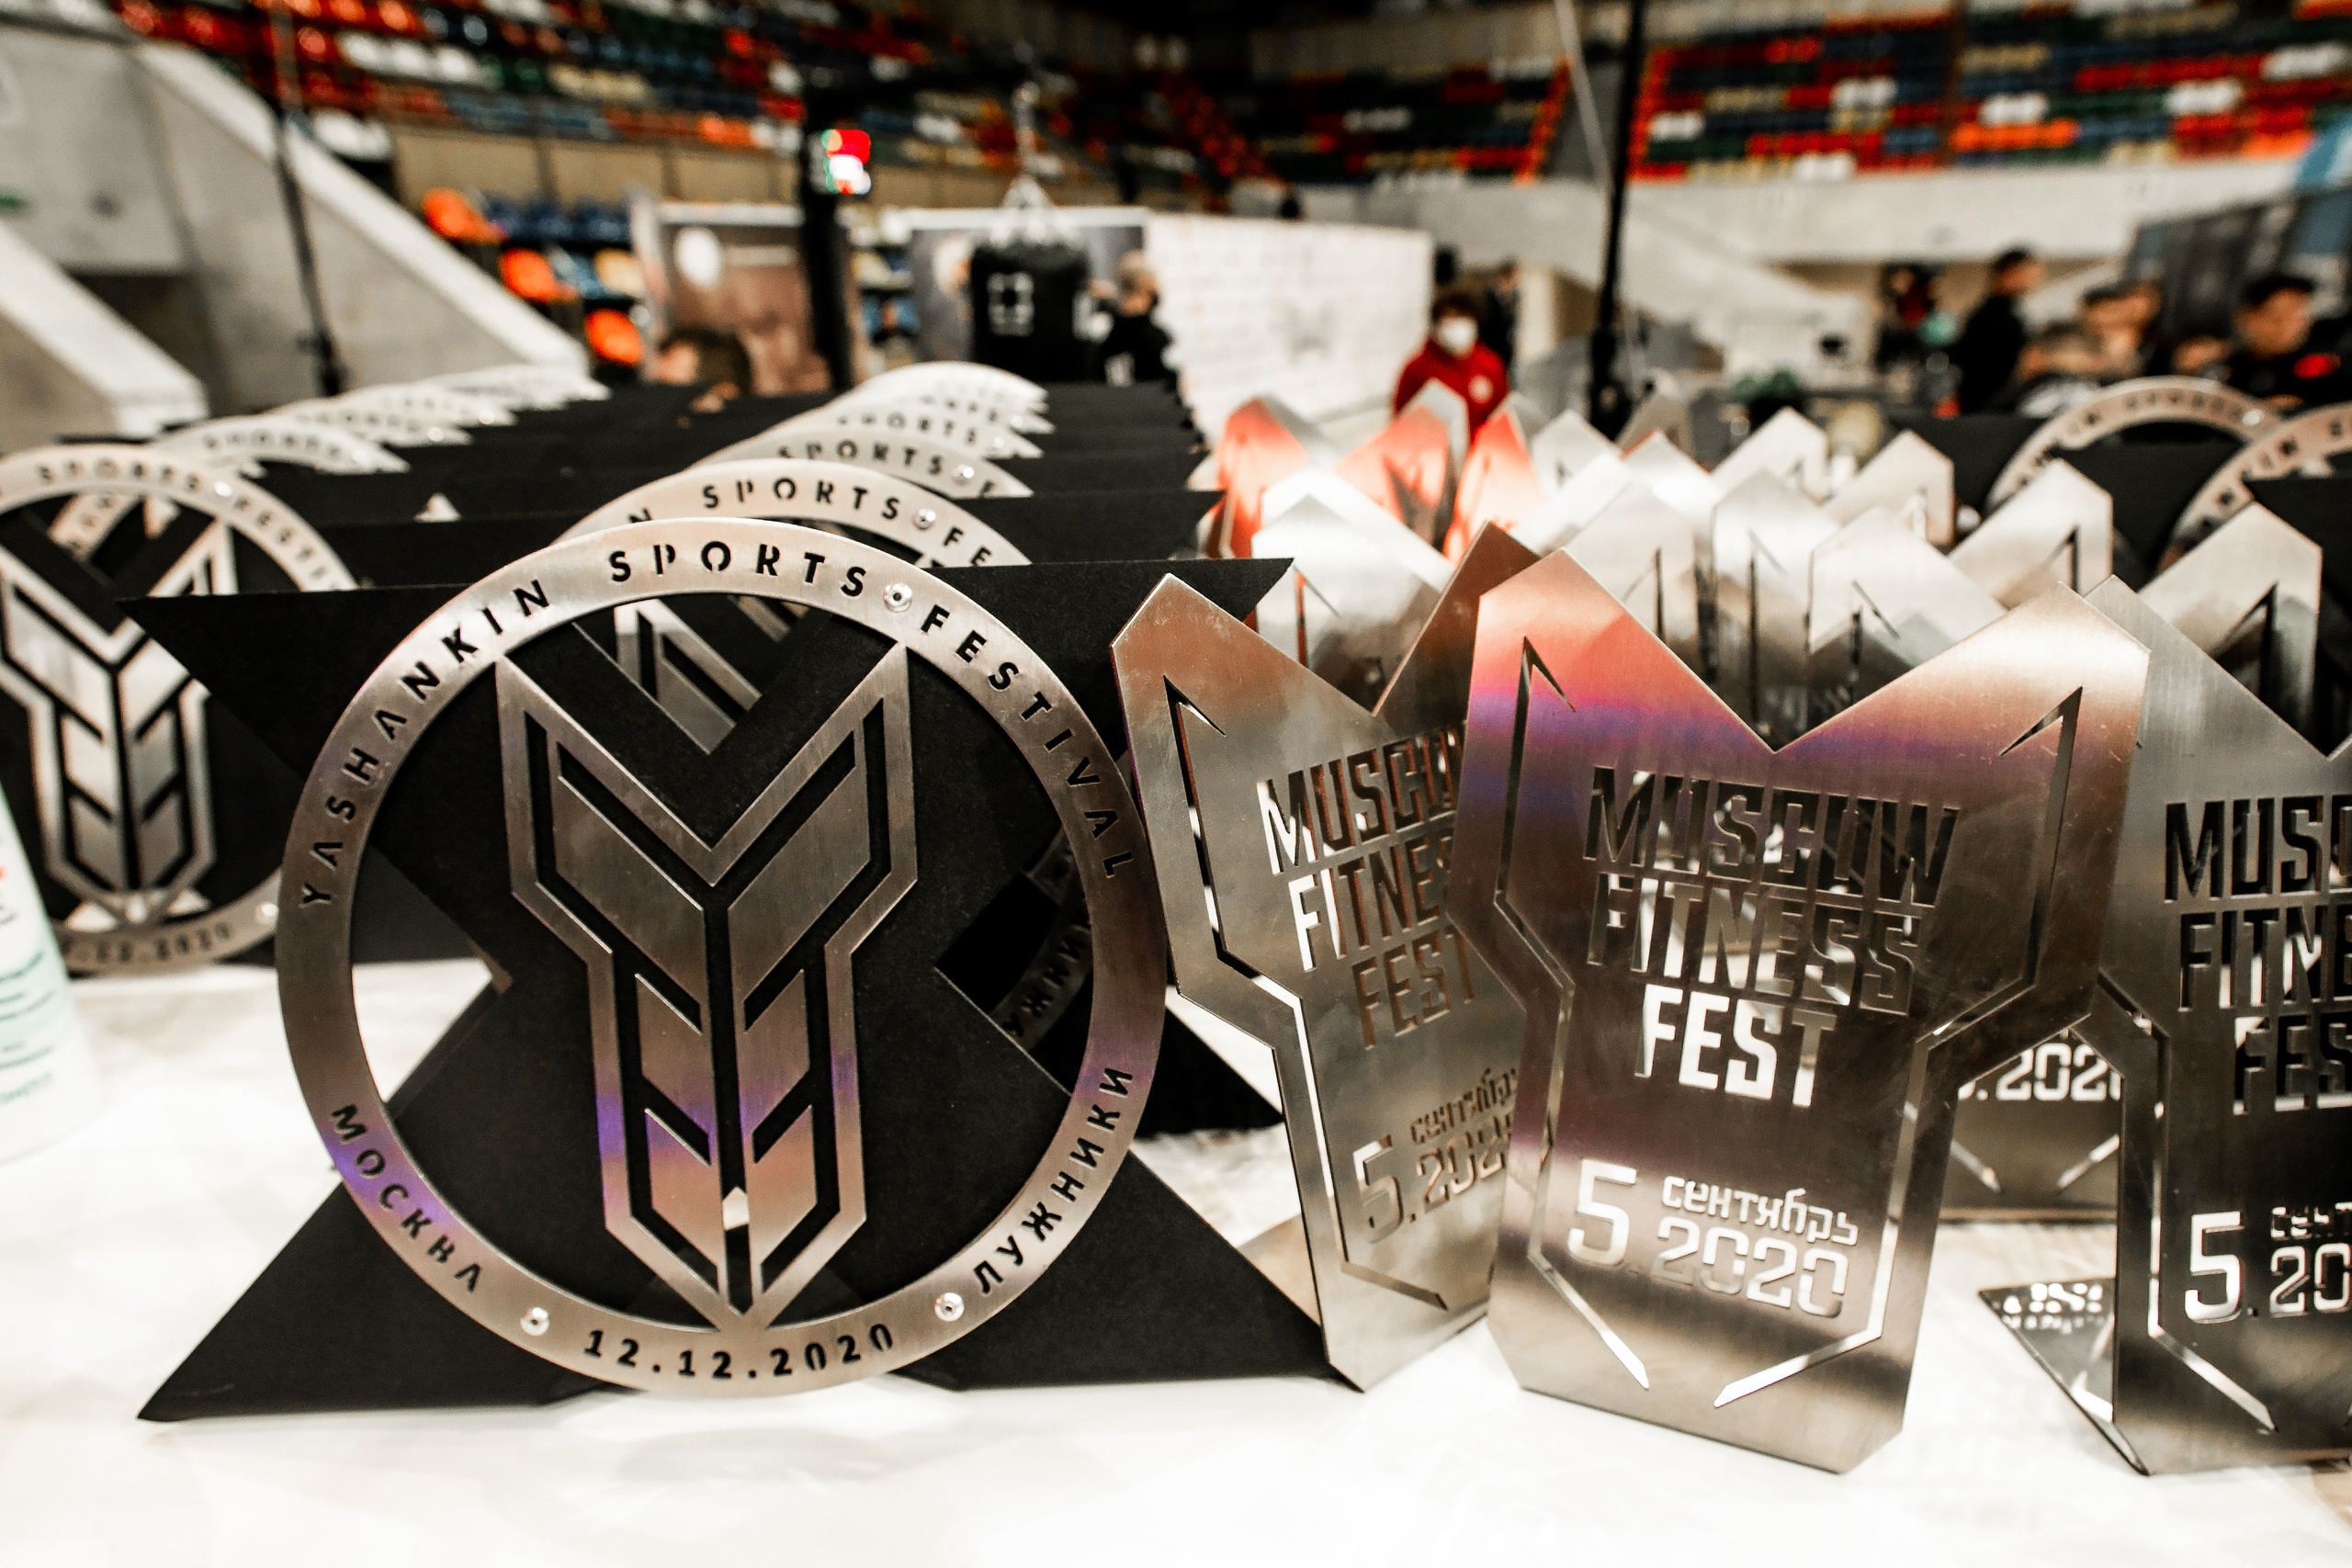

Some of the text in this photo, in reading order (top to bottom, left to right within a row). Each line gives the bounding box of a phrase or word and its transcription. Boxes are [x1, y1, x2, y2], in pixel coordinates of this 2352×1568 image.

[702, 478, 901, 521] SPORTS
[299, 540, 1134, 909] YASHANKIN SPORTS FESTIVAL
[1351, 923, 1474, 1052] FEST
[1587, 872, 1923, 1017] FITNESS
[1634, 983, 1838, 1109] FEST
[331, 1103, 482, 1294] МОСКВА
[973, 1067, 1134, 1295] ЛУЖНИКИ
[1661, 1175, 1860, 1246] сентябрь
[582, 1323, 895, 1381] 12.12.2020
